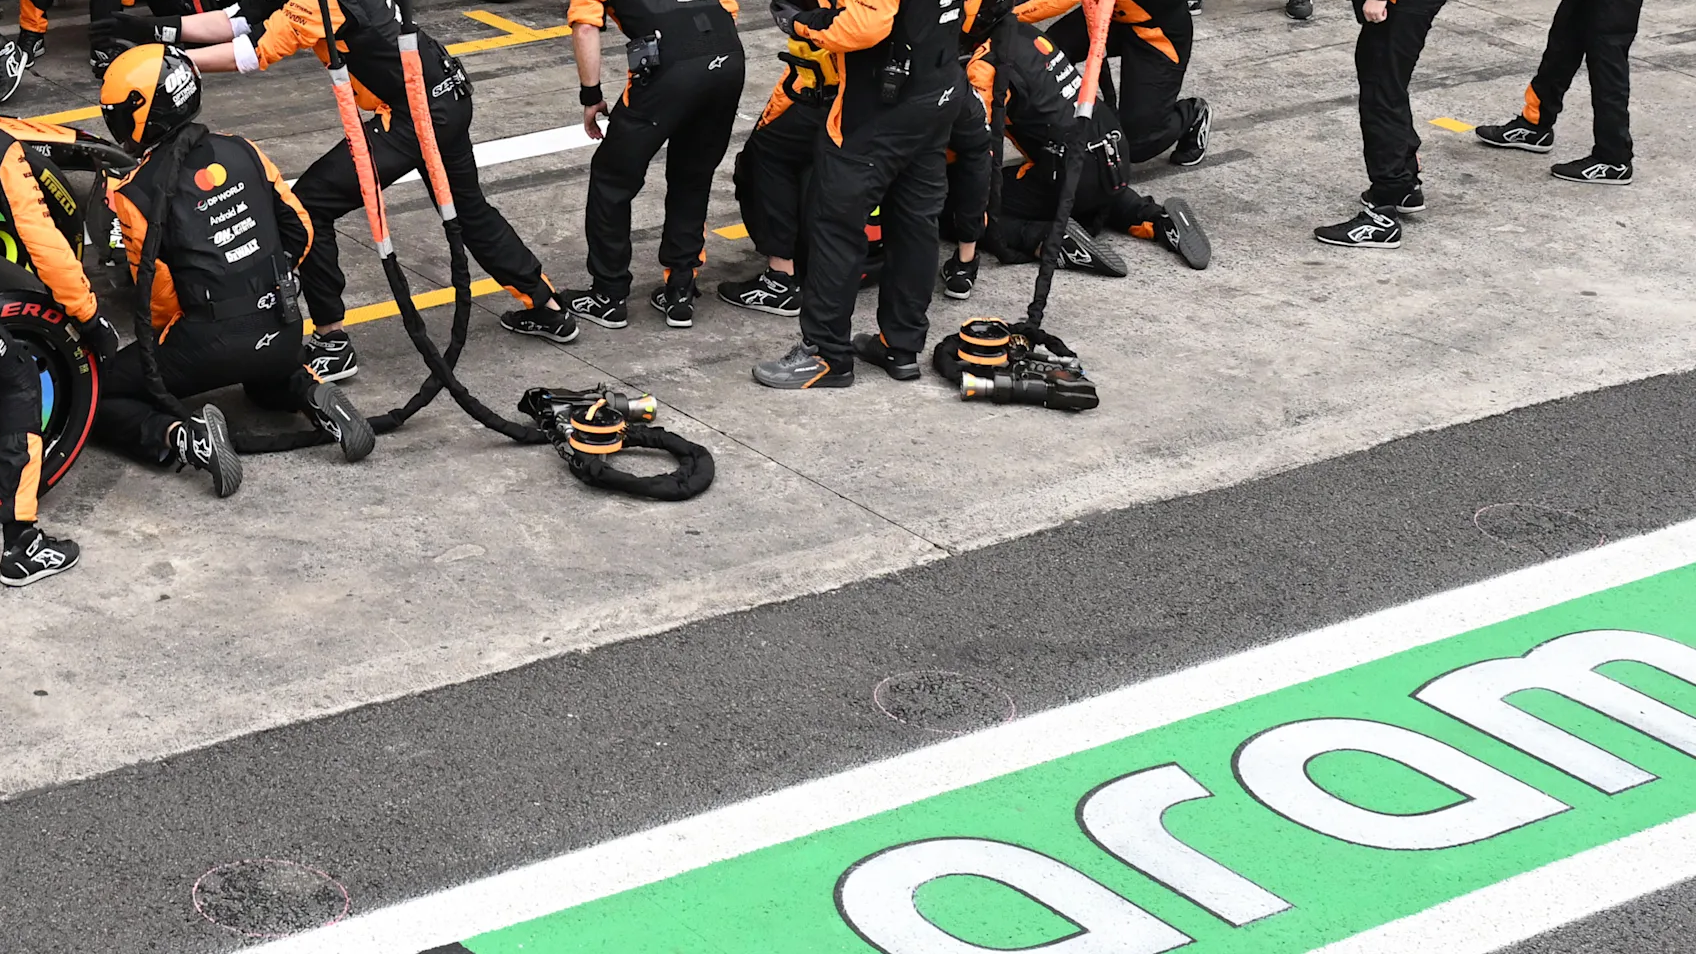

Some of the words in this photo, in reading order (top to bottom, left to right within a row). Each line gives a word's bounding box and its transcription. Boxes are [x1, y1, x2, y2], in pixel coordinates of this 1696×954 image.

[165, 65, 191, 92] ON
[39, 168, 77, 216] PIRELLI
[207, 196, 218, 206] DP
[217, 182, 245, 202] WORLD
[210, 206, 237, 226] Android
